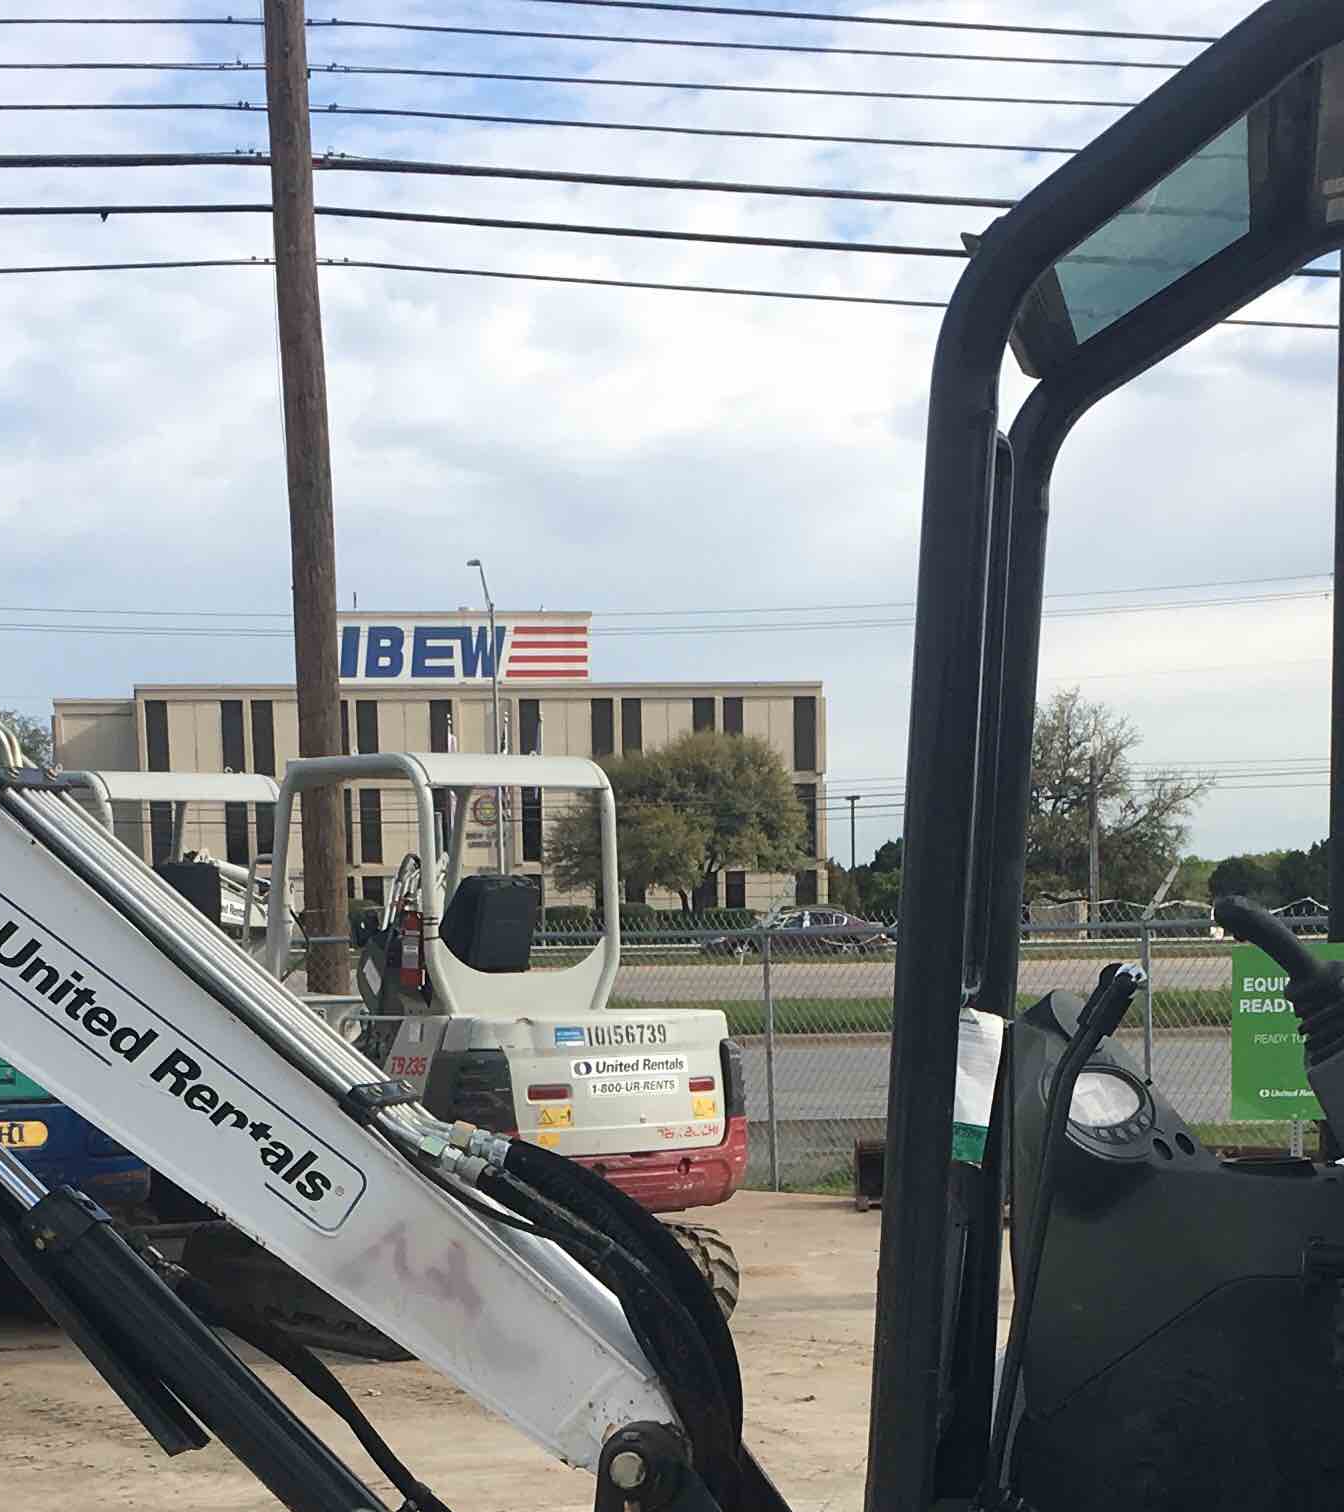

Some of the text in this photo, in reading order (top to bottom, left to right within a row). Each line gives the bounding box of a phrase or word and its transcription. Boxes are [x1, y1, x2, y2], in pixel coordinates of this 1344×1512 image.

[339, 626, 506, 678] IBEW
[596, 1057, 684, 1074] United Rentals
[592, 1079, 675, 1094] 1-800-UR-RENTS
[149, 1048, 333, 1203] Rentals
